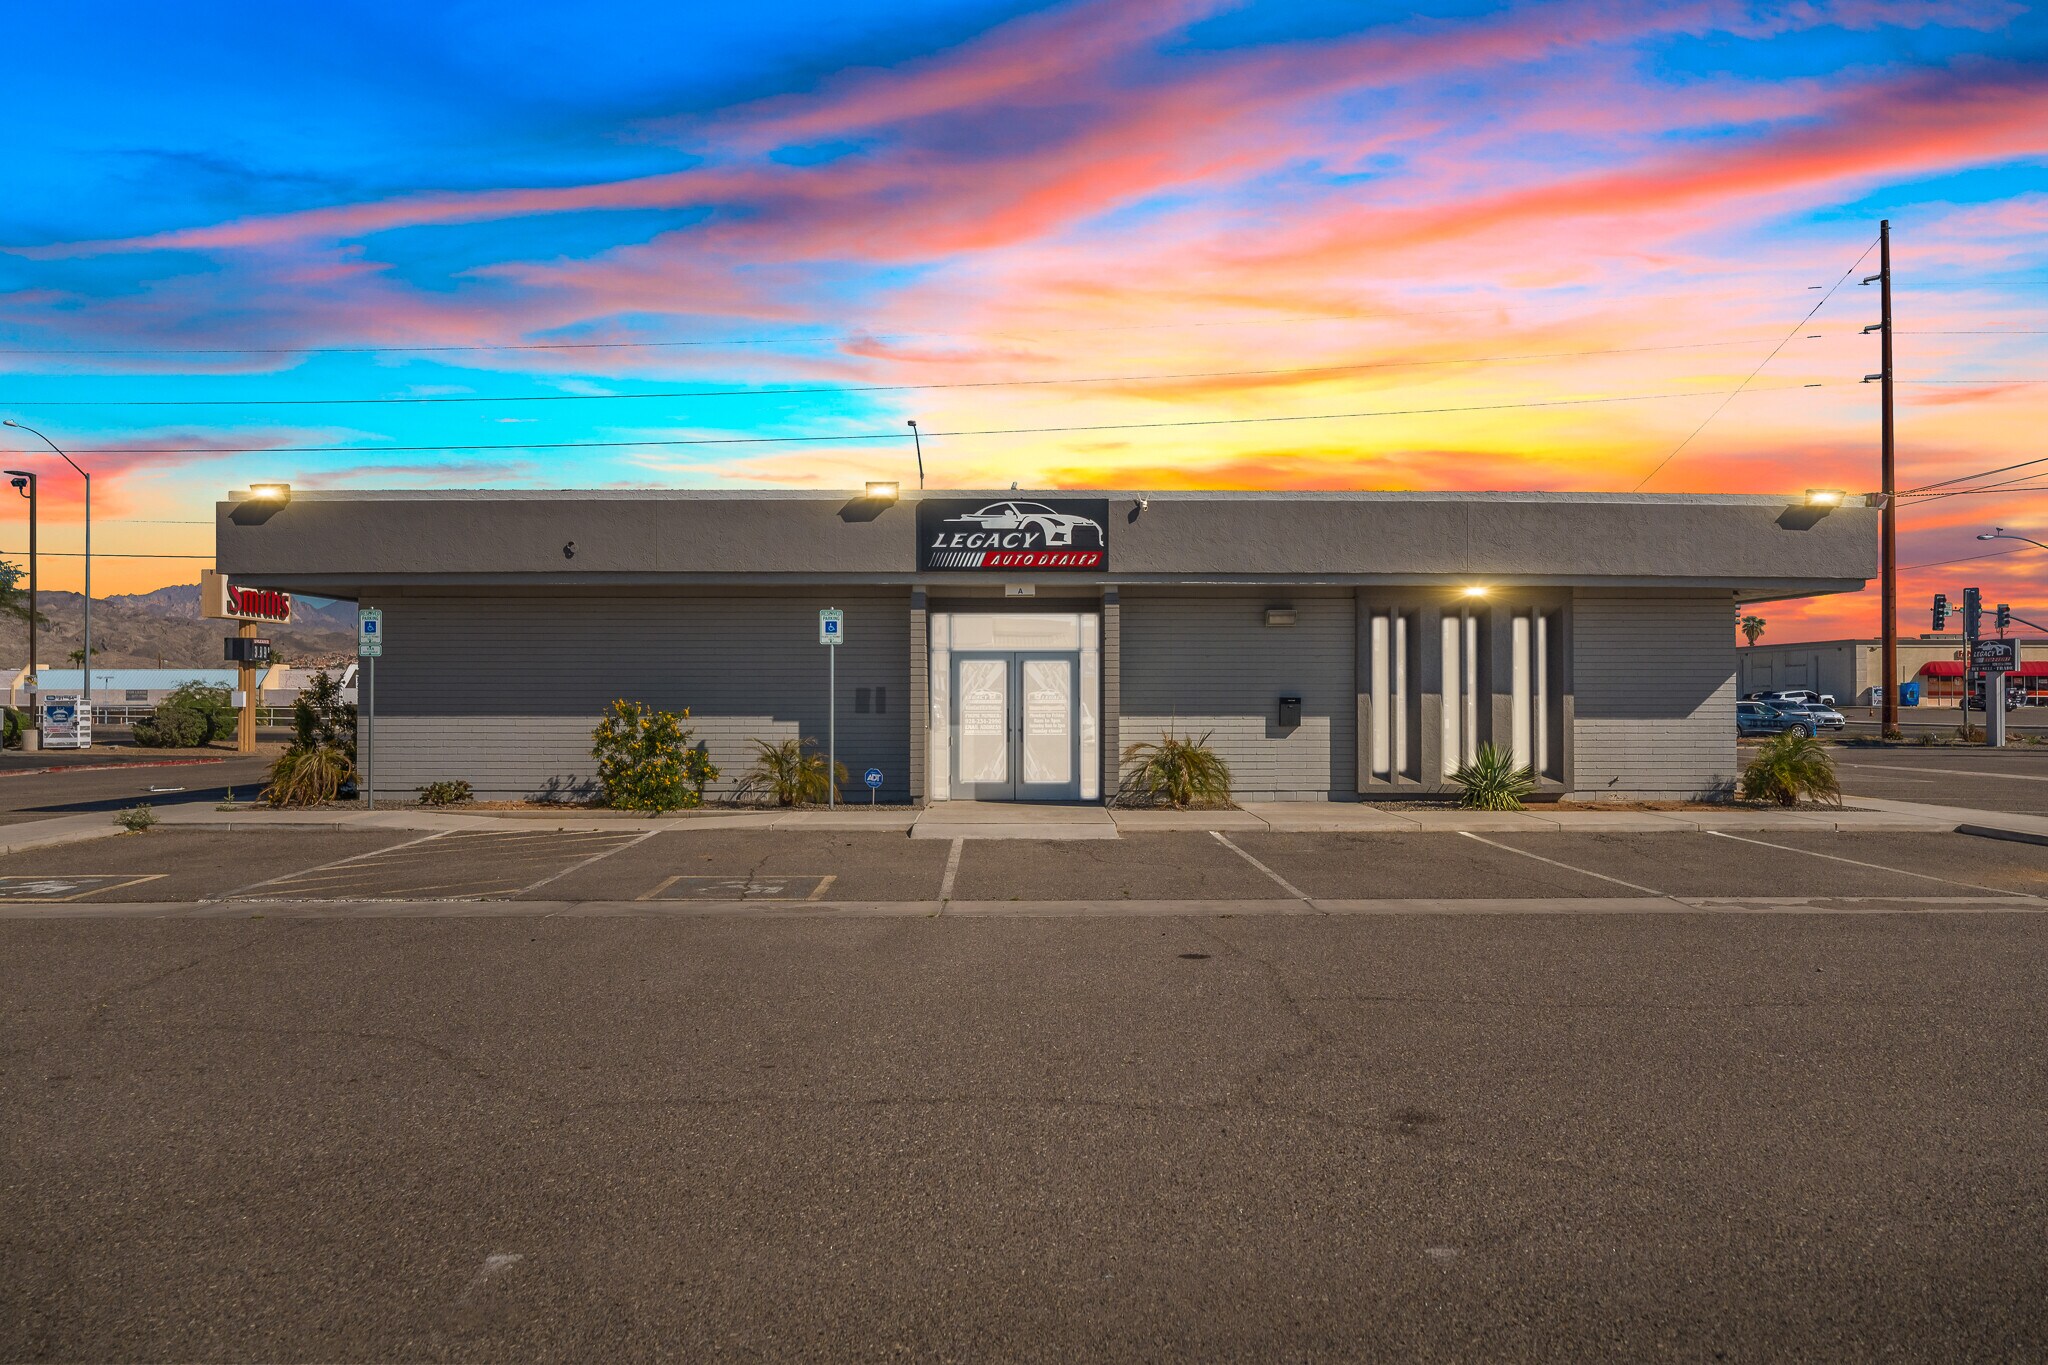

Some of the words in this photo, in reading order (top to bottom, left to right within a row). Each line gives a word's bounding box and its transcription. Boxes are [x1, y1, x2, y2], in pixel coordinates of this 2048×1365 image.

[931, 532, 1040, 549] LEGACY
[990, 553, 1034, 566] AUTO
[1037, 553, 1101, 566] DEALER
[1017, 587, 1024, 595] A
[1973, 650, 1996, 658] LEGACY
[867, 774, 881, 782] ADT
